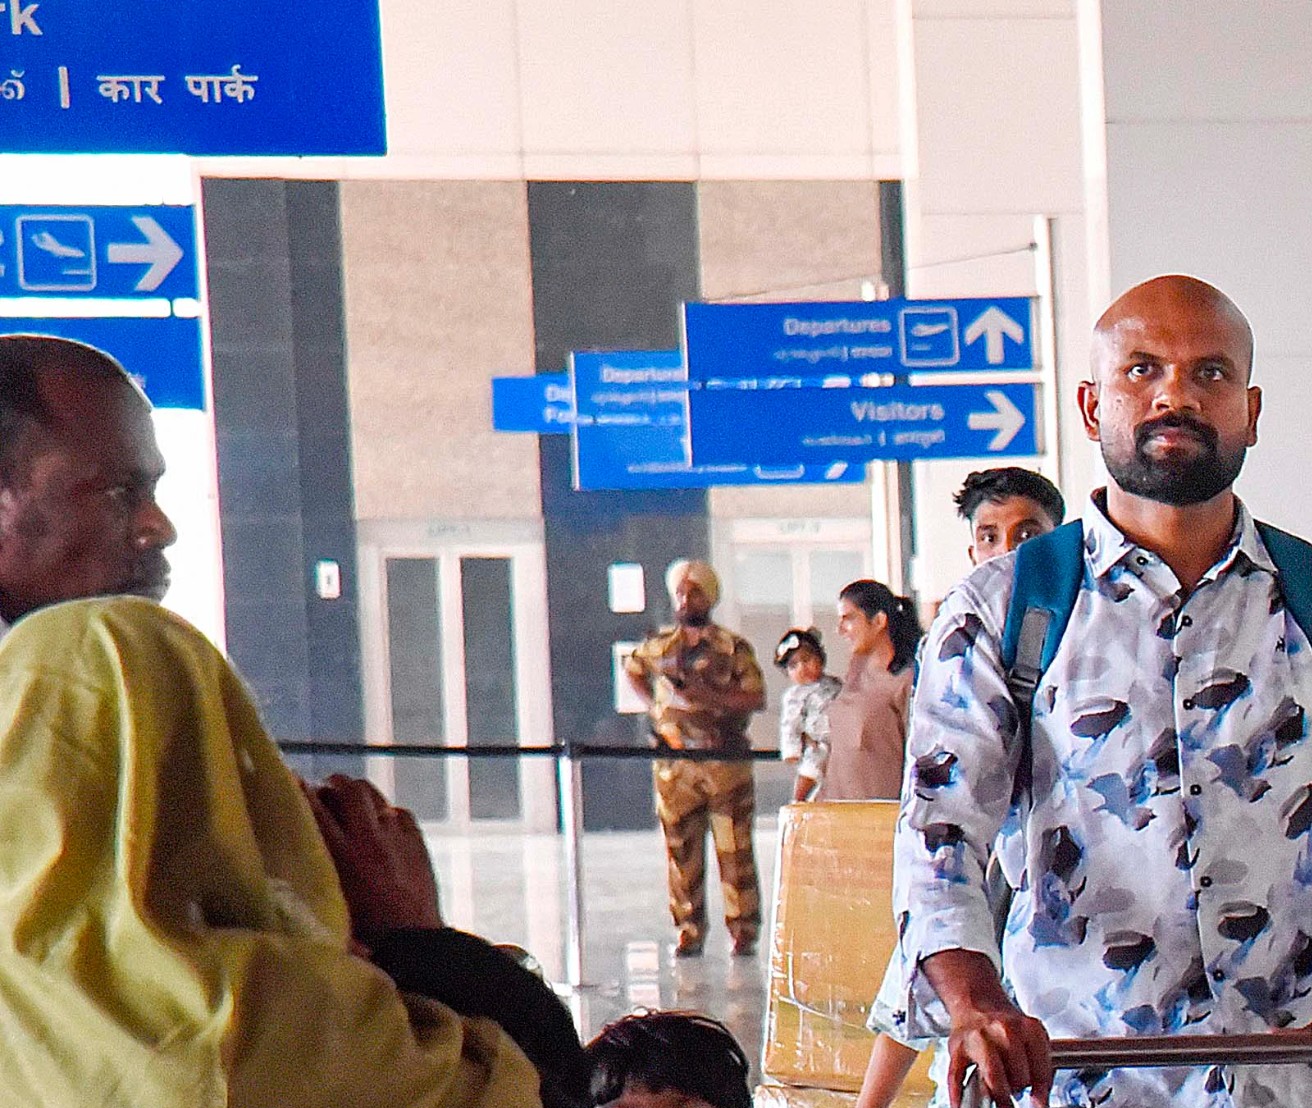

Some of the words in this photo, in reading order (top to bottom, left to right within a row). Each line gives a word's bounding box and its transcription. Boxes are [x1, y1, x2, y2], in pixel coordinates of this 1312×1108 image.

[97, 75, 165, 104] कार
[185, 64, 258, 103] पार्क
[784, 317, 892, 337] Departures
[851, 401, 946, 421] Visitors
